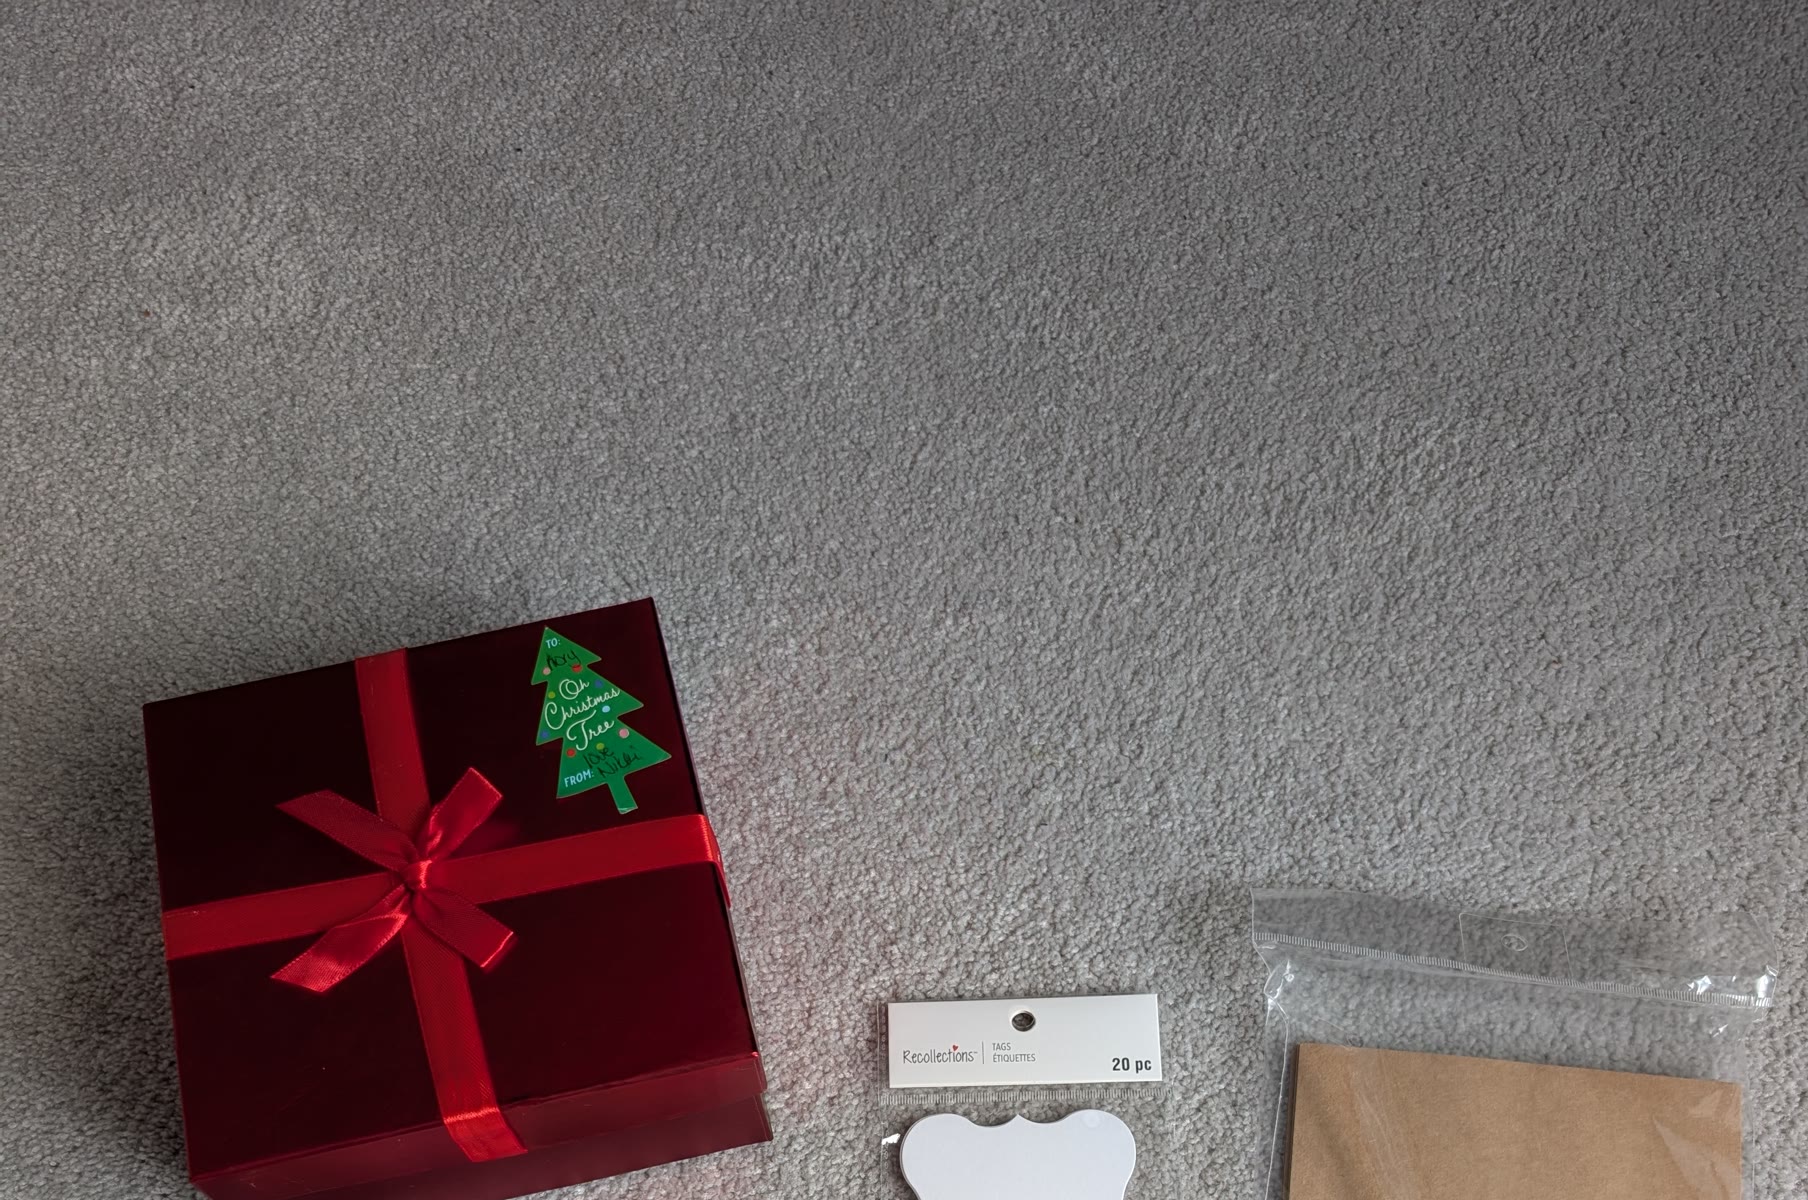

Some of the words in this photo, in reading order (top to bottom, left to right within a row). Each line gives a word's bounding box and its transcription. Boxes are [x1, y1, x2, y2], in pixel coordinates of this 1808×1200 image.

[546, 637, 561, 649] TO:
[558, 678, 590, 700] Oh
[544, 688, 620, 730] Christmas
[566, 710, 615, 751] Tree
[564, 769, 594, 788] FROM:
[992, 1042, 1012, 1052] TAGS
[902, 1048, 976, 1065] Recollections
[992, 1052, 1036, 1064] ÉTIQUETTES
[1112, 1057, 1131, 1072] 20
[1135, 1058, 1152, 1074] pc
